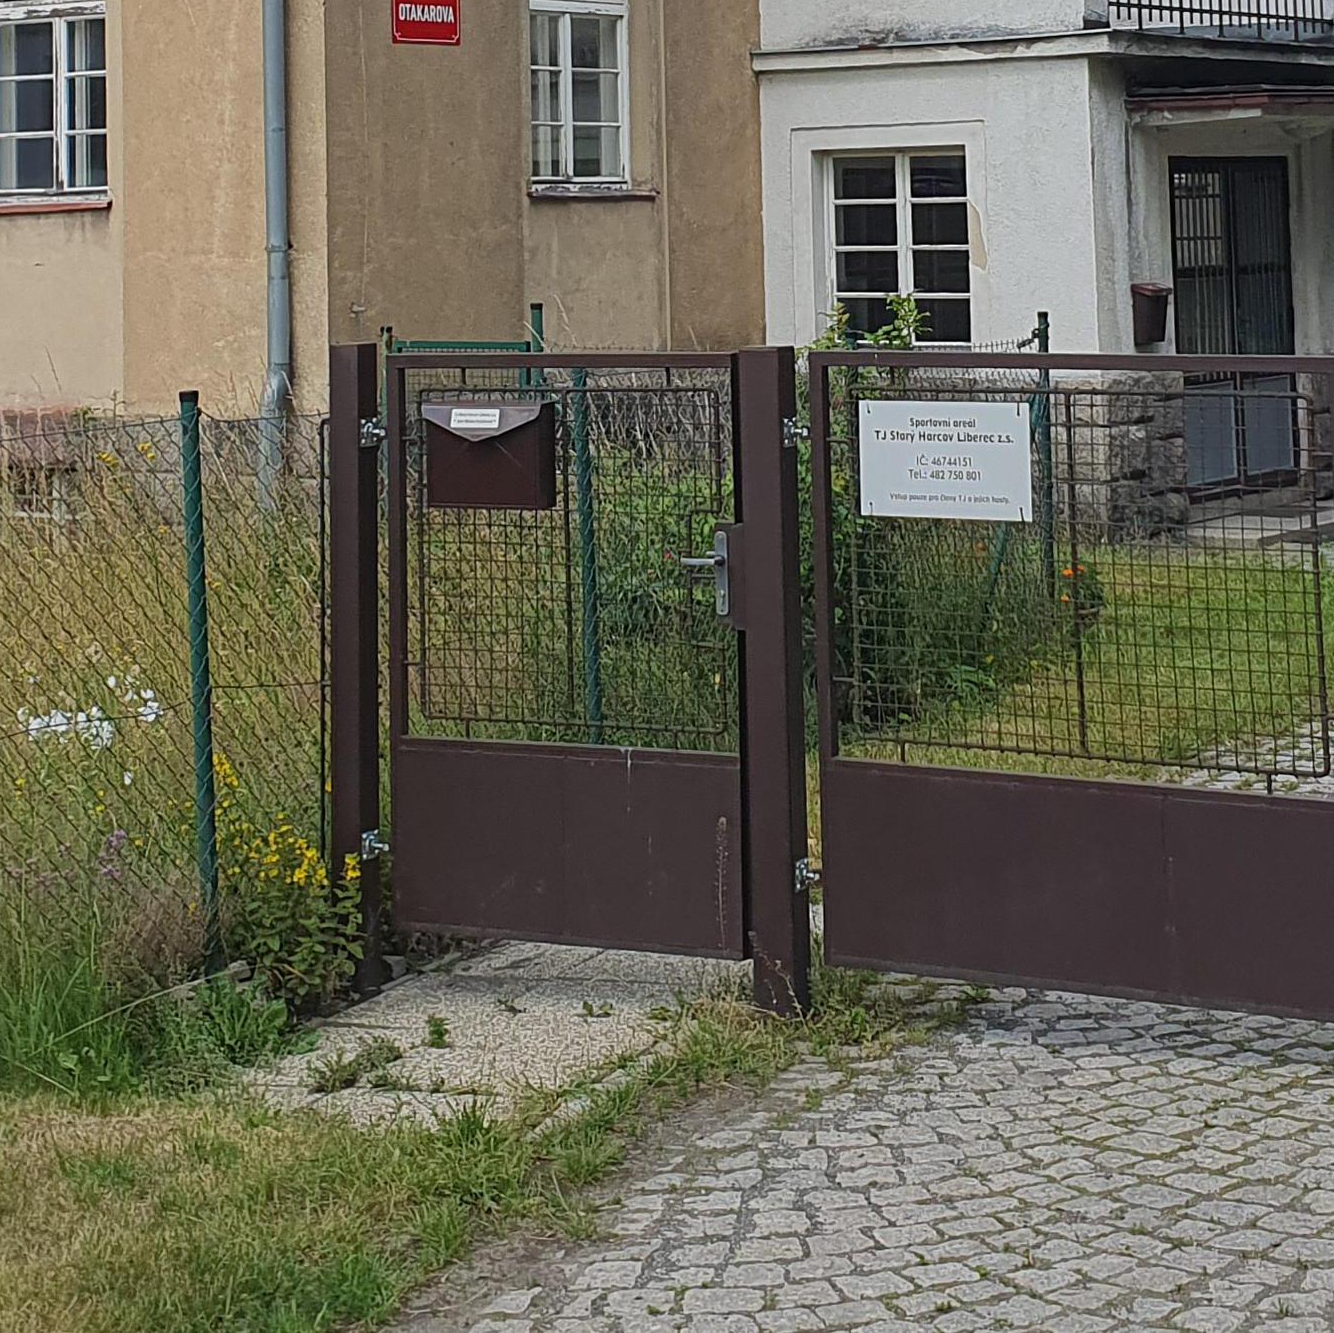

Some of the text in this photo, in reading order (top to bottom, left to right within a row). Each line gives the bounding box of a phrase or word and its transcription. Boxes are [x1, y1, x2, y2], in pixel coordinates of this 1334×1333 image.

[398, 3, 455, 23] OTAKAROVA
[874, 429, 1015, 443] TJ Starý Harcov Liberec z.s.
[931, 456, 972, 467] 46744151
[929, 470, 945, 480] 482
[948, 470, 964, 480] 750
[966, 470, 981, 481] 801
